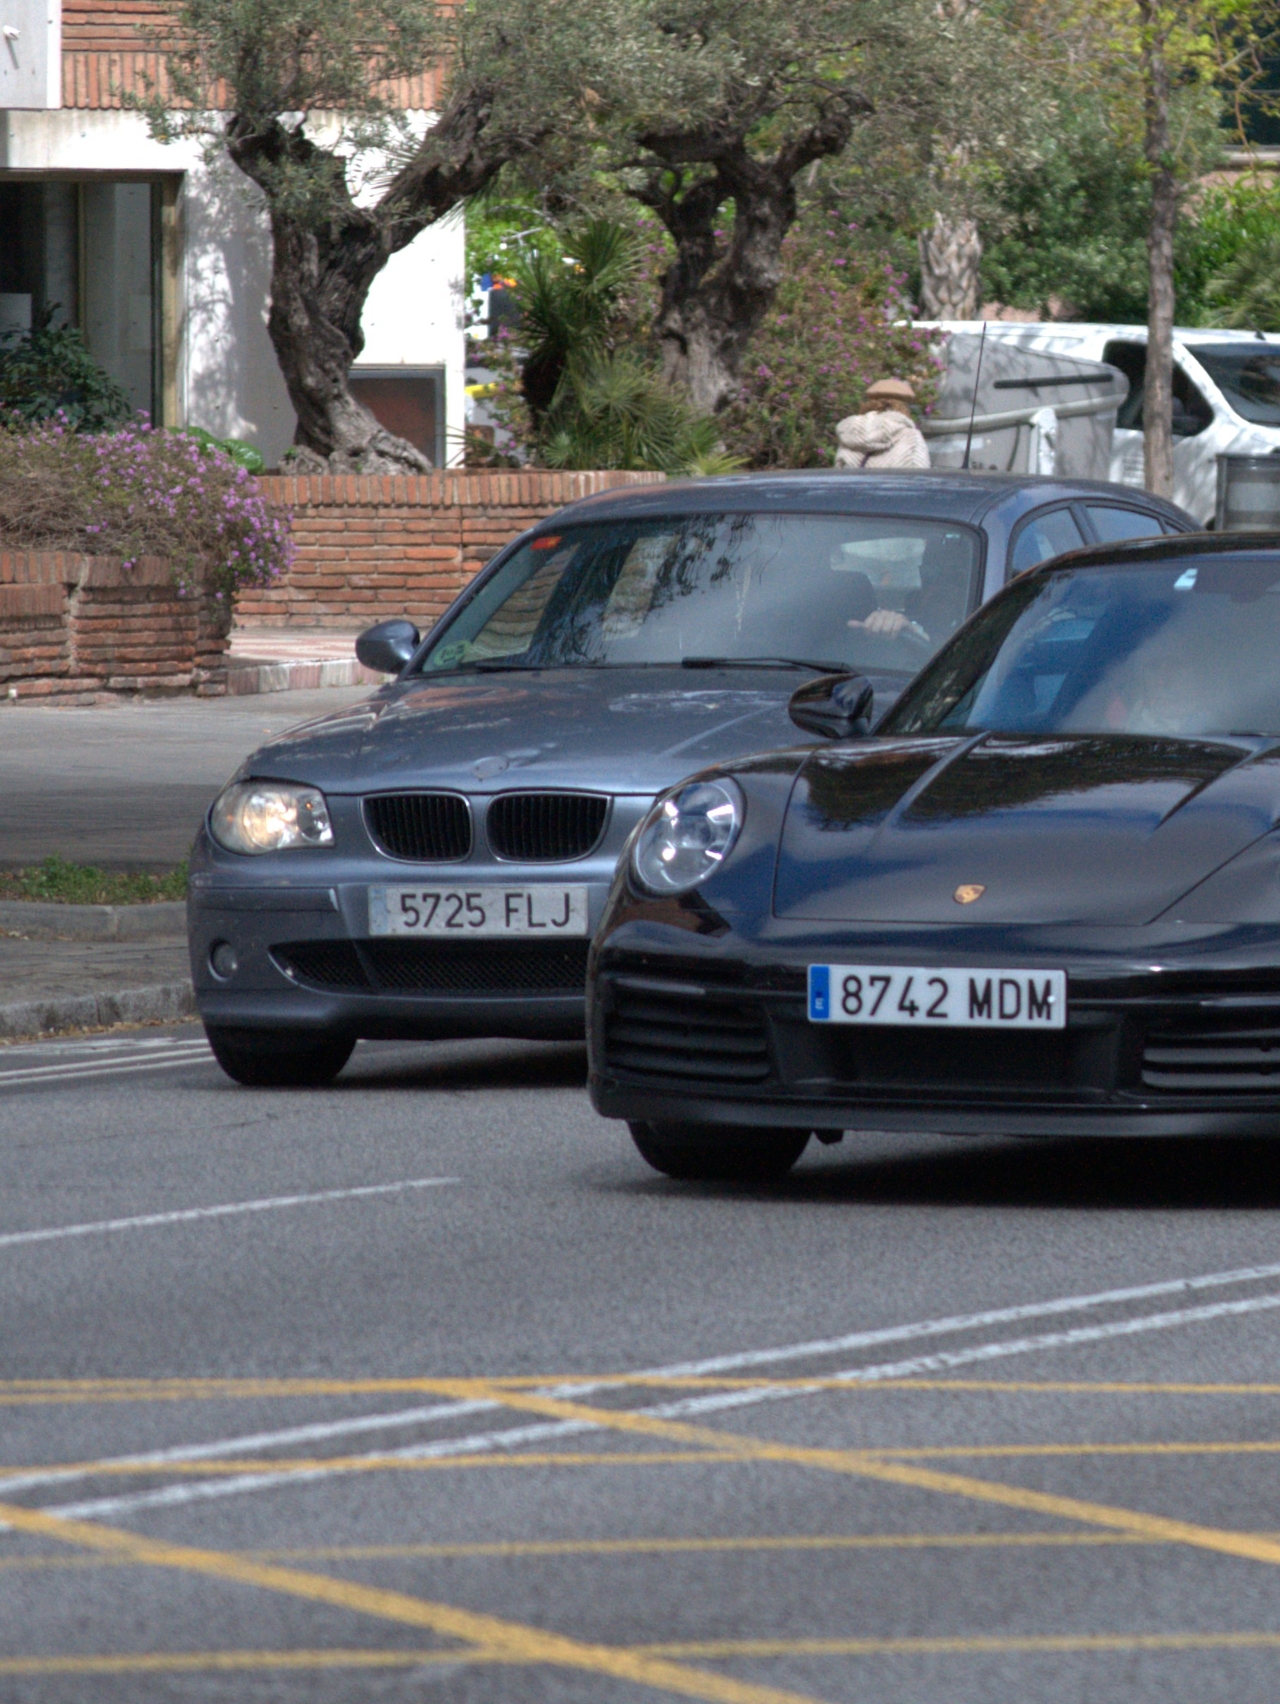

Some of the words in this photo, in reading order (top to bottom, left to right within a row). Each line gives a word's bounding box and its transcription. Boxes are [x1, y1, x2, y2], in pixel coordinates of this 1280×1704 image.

[400, 893, 486, 928] 5725
[504, 893, 571, 928] FLJ
[841, 974, 949, 1019] 8742
[968, 977, 1052, 1021] MDM
